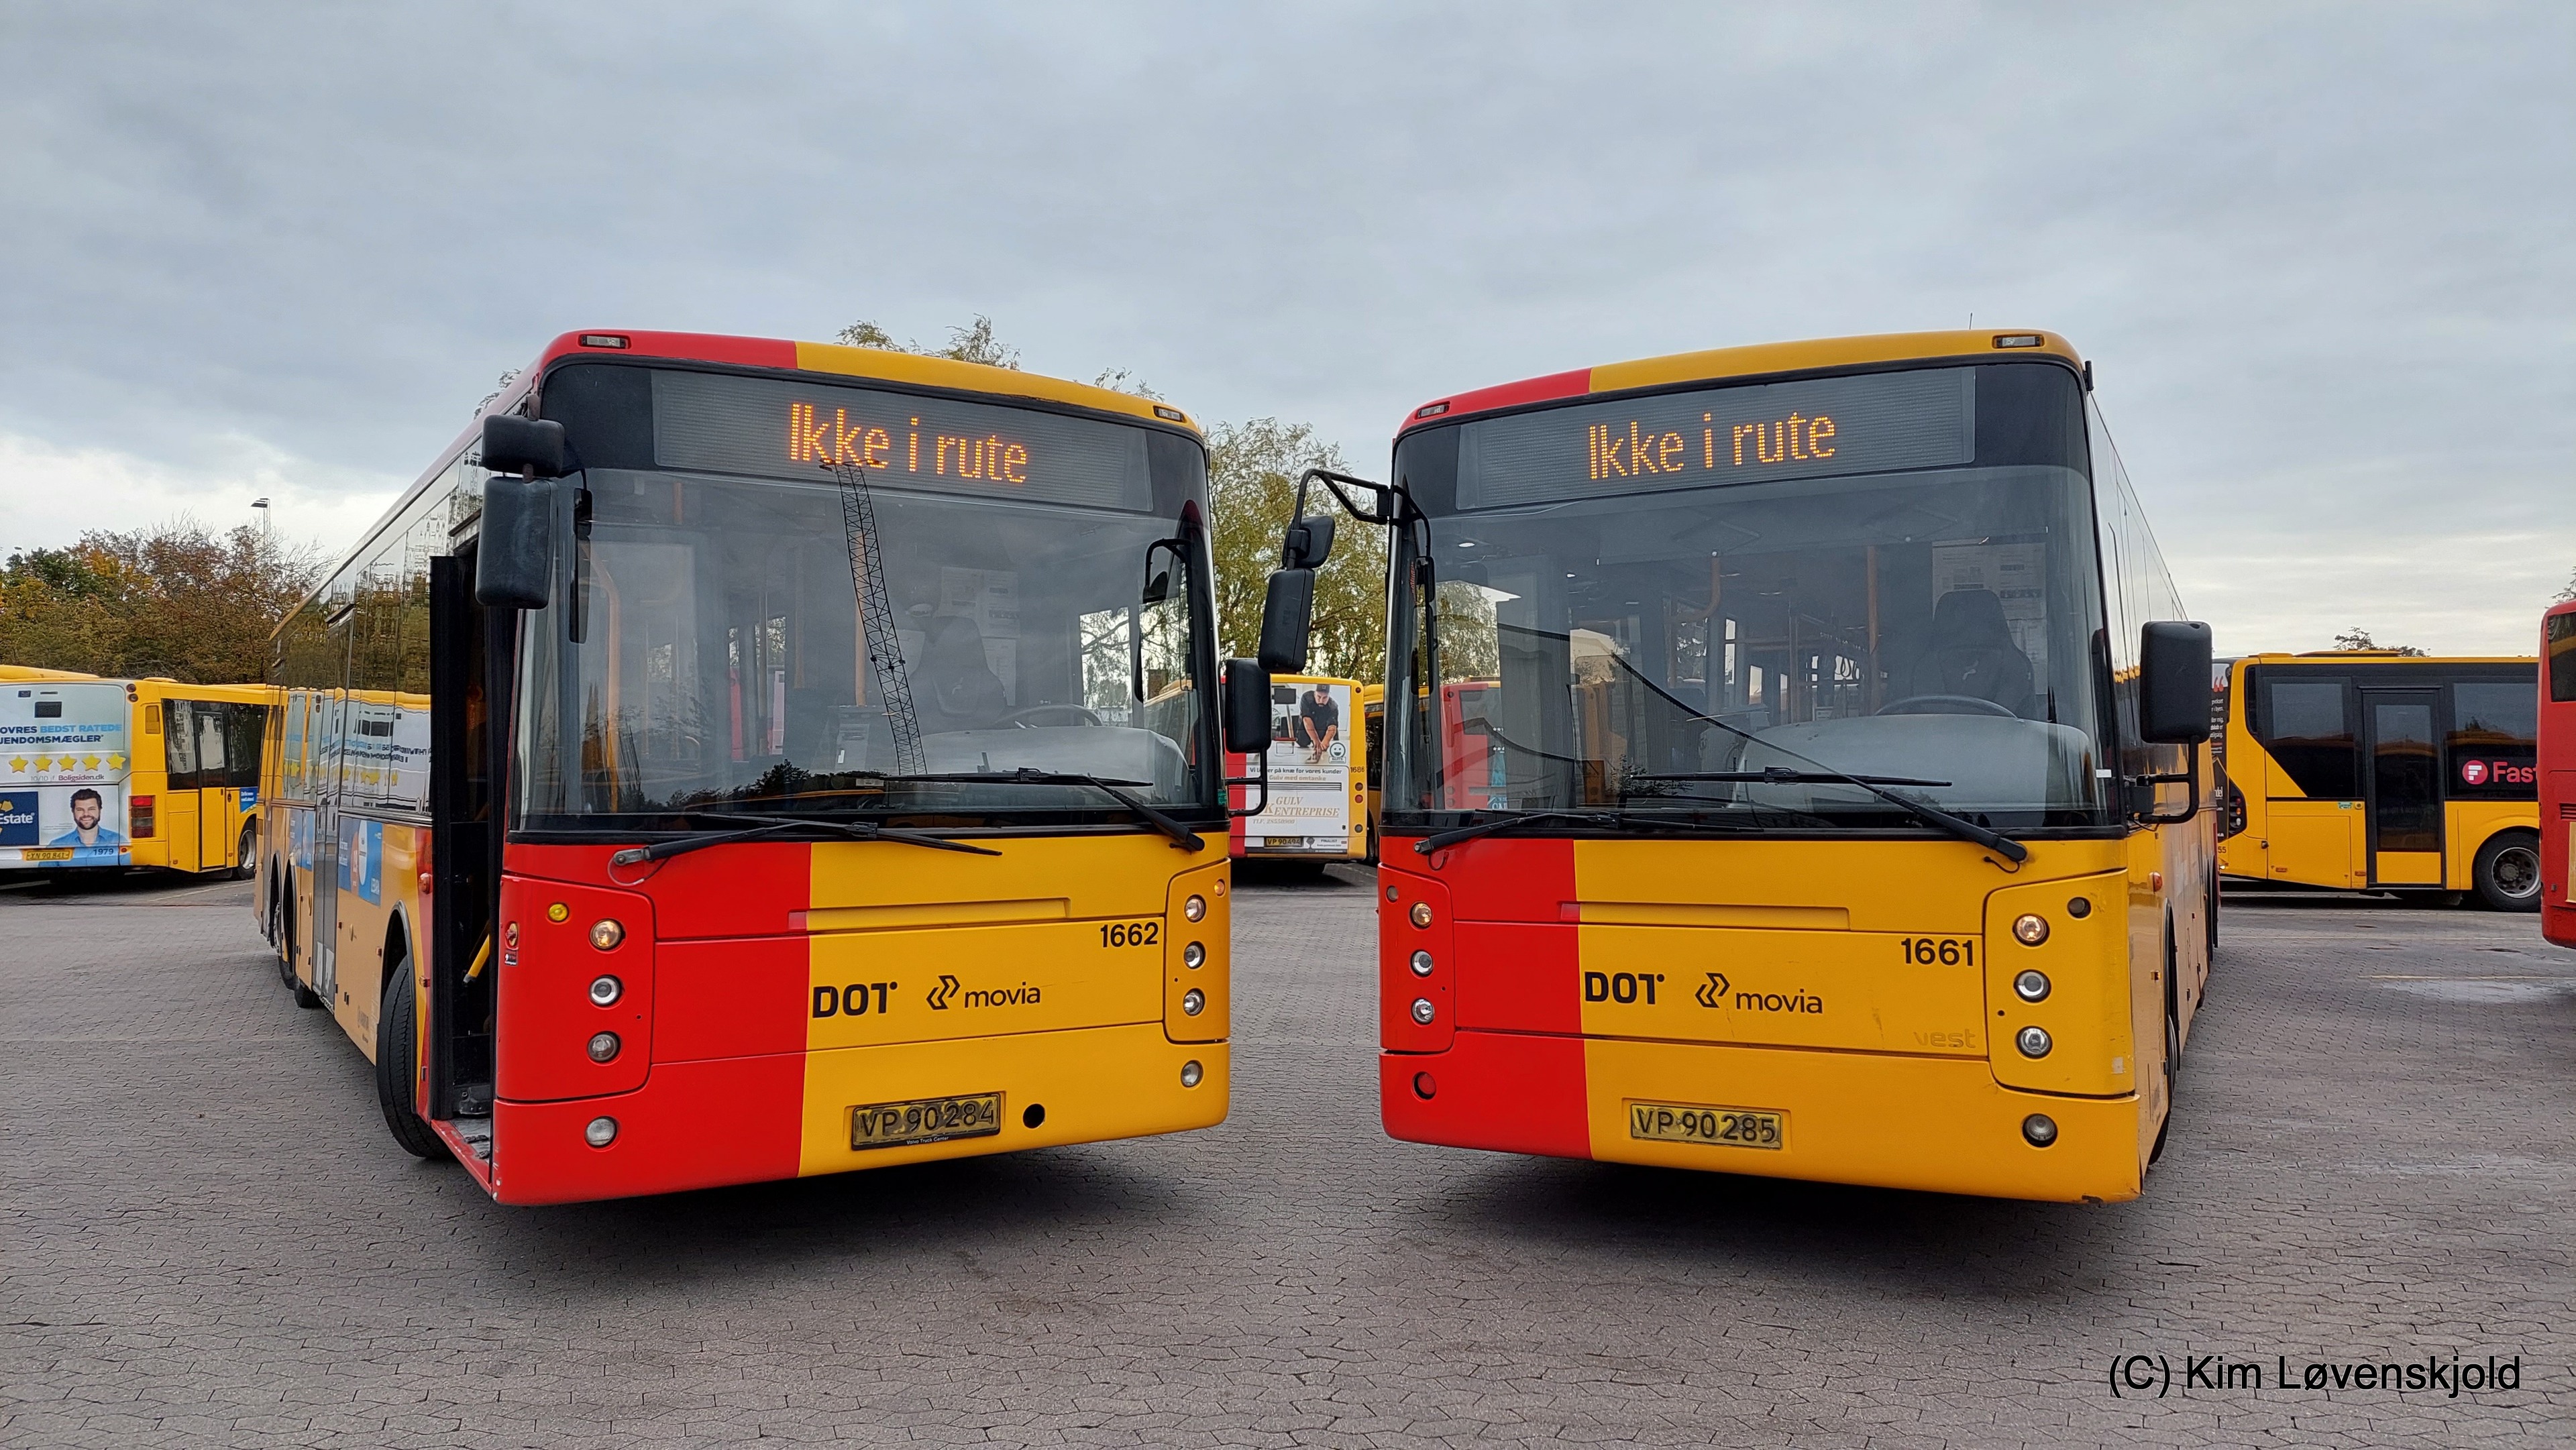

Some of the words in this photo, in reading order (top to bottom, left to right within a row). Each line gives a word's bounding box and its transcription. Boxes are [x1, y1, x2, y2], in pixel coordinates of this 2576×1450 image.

[790, 403, 890, 469] Ikke
[908, 416, 920, 472] i
[936, 434, 1028, 484] rute
[1589, 421, 1685, 480] Ikke
[1703, 411, 1713, 469] i
[1733, 410, 1836, 466] rute
[40, 725, 76, 733] BEDST
[78, 724, 122, 732] RATEDE
[58, 774, 105, 782] Boligsiden.dk
[1274, 807, 1340, 816] ENTREPRISE
[1276, 796, 1303, 805] GULV
[1100, 922, 1159, 948] 1662
[1900, 938, 1974, 966] 1661
[812, 981, 898, 1018] DOT
[964, 981, 1041, 1009] movia
[1585, 971, 1665, 1005] DOT
[1735, 988, 1823, 1015] movia
[1914, 1028, 1976, 1049] vest
[859, 1111, 898, 1138] VP
[1636, 1108, 1674, 1135] VP
